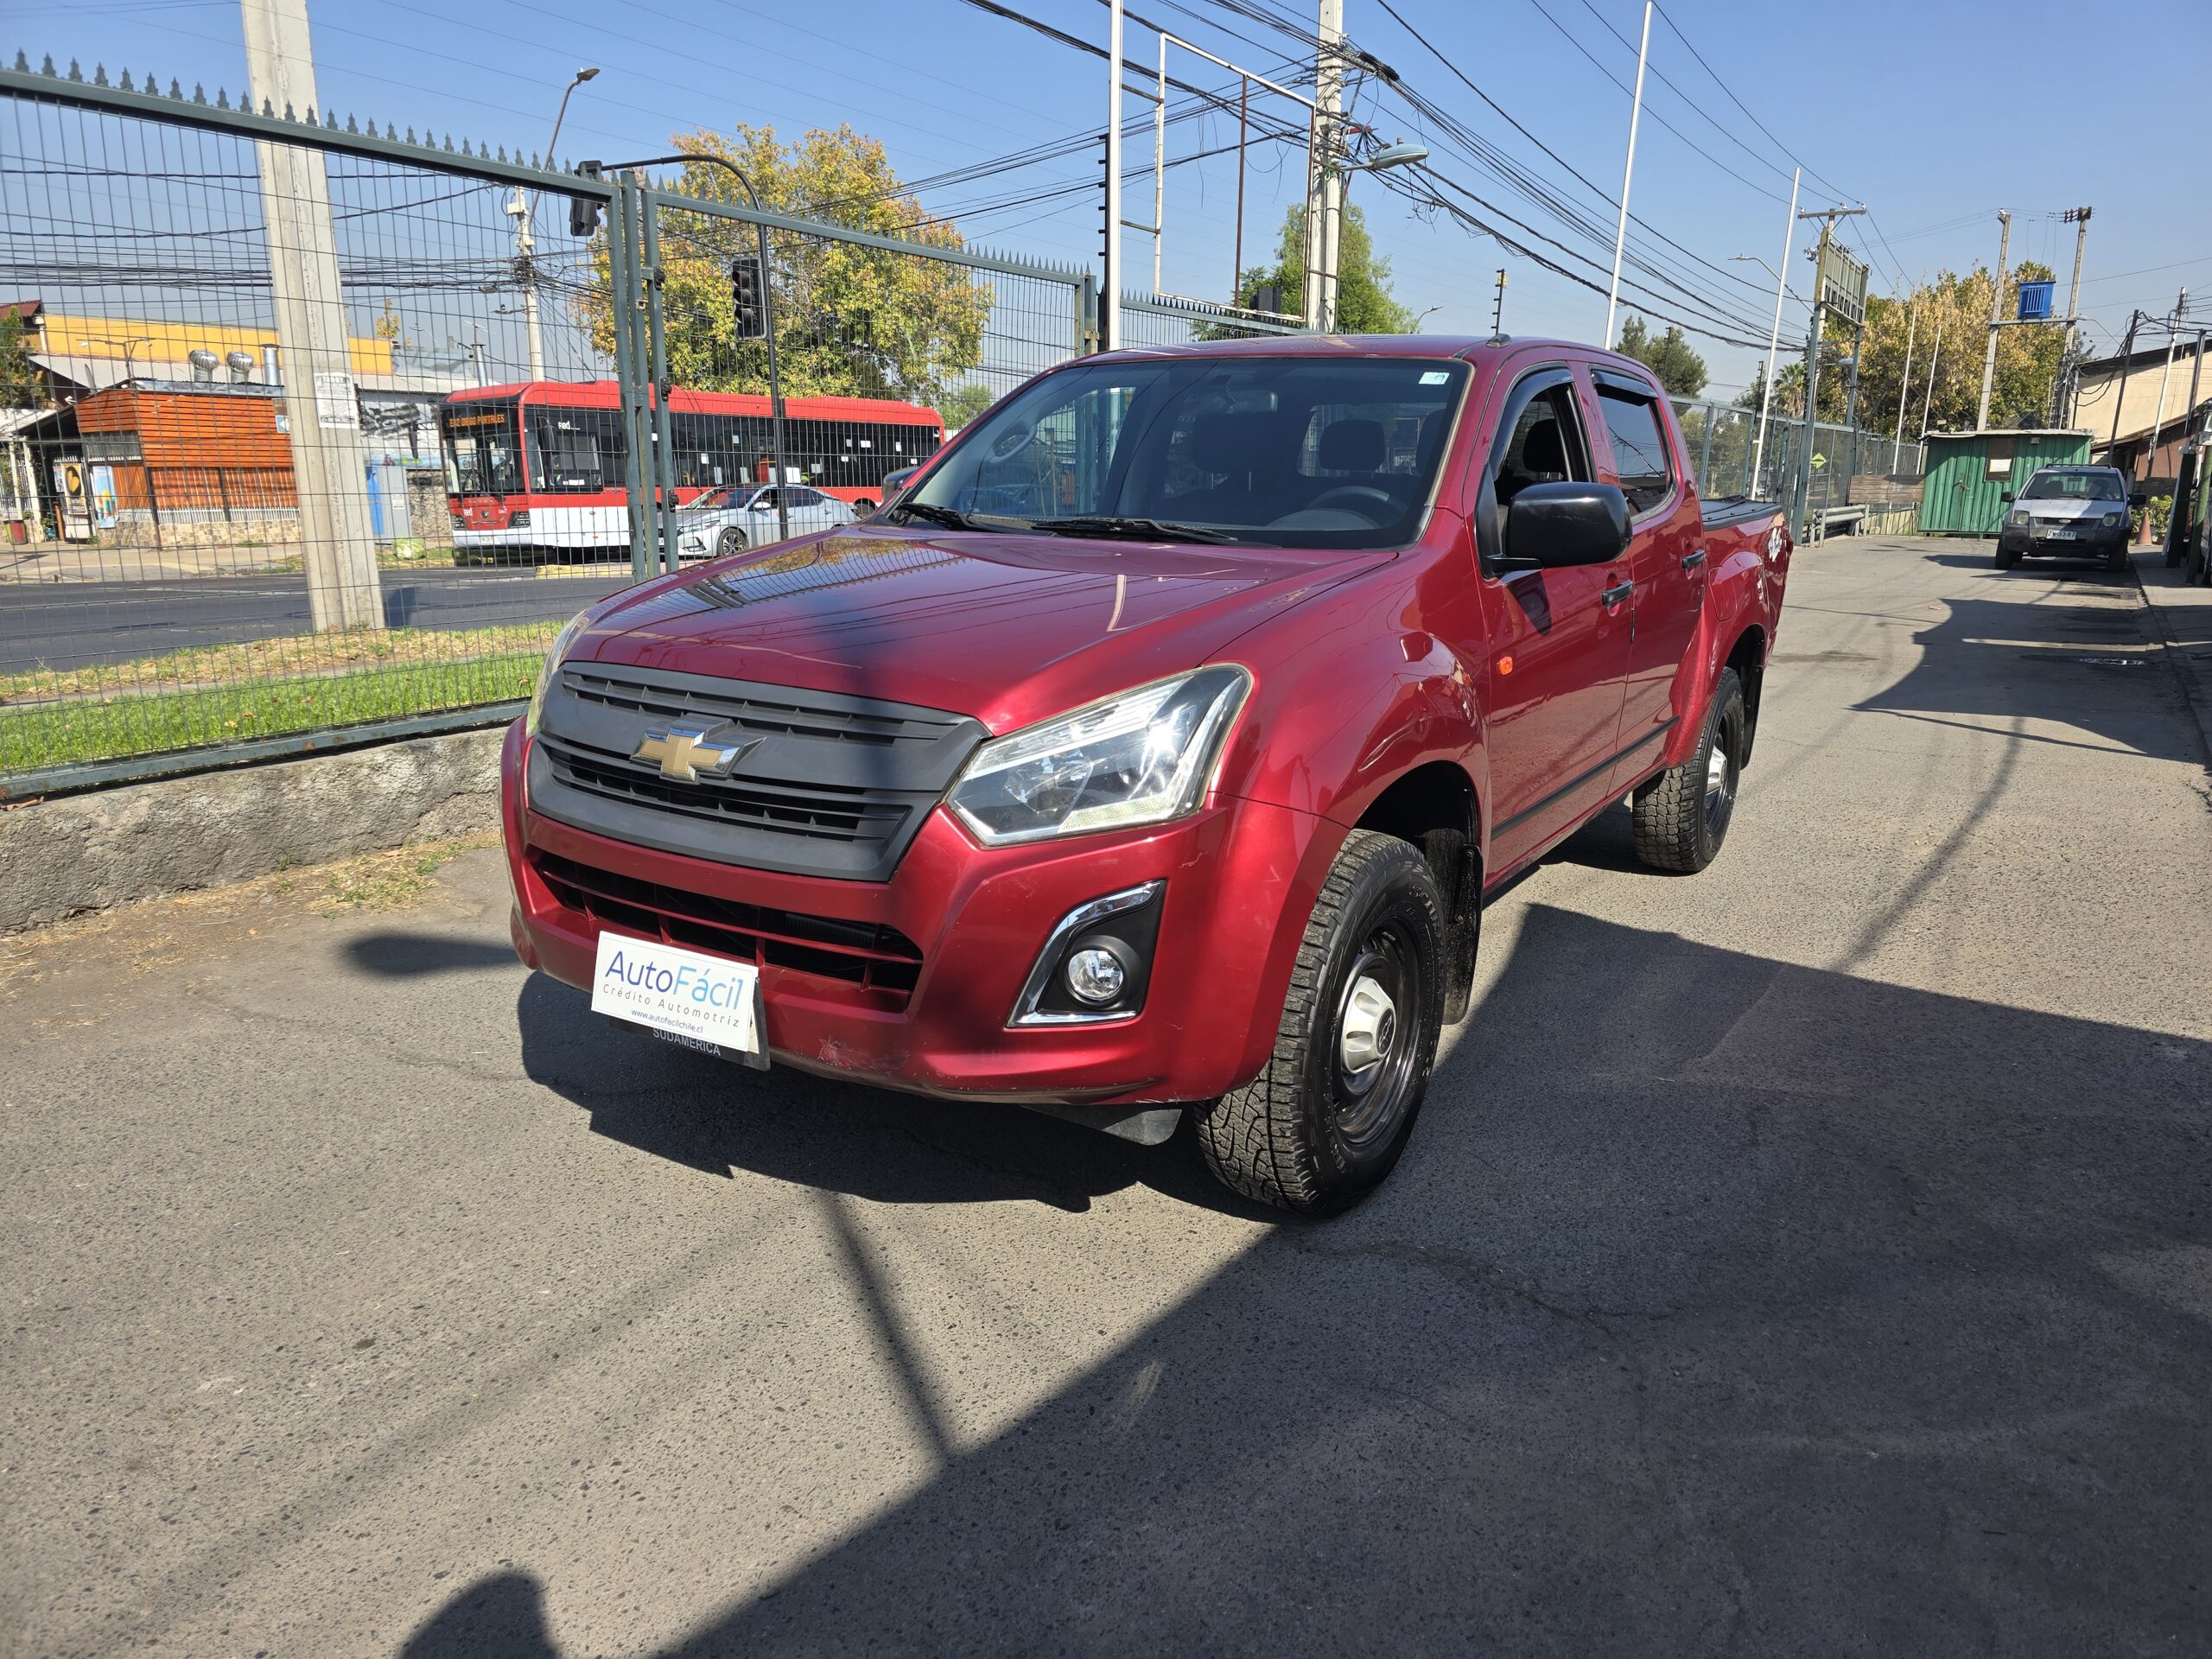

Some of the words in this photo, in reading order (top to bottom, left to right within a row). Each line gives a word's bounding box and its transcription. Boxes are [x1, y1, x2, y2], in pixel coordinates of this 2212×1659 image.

[605, 950, 744, 1010] AutoFácil
[603, 983, 651, 1005] Crédito
[658, 999, 740, 1027] Automotriz
[631, 1009, 703, 1033] www.autofacilchile.cl
[652, 1027, 721, 1057] SUDAMERICA
